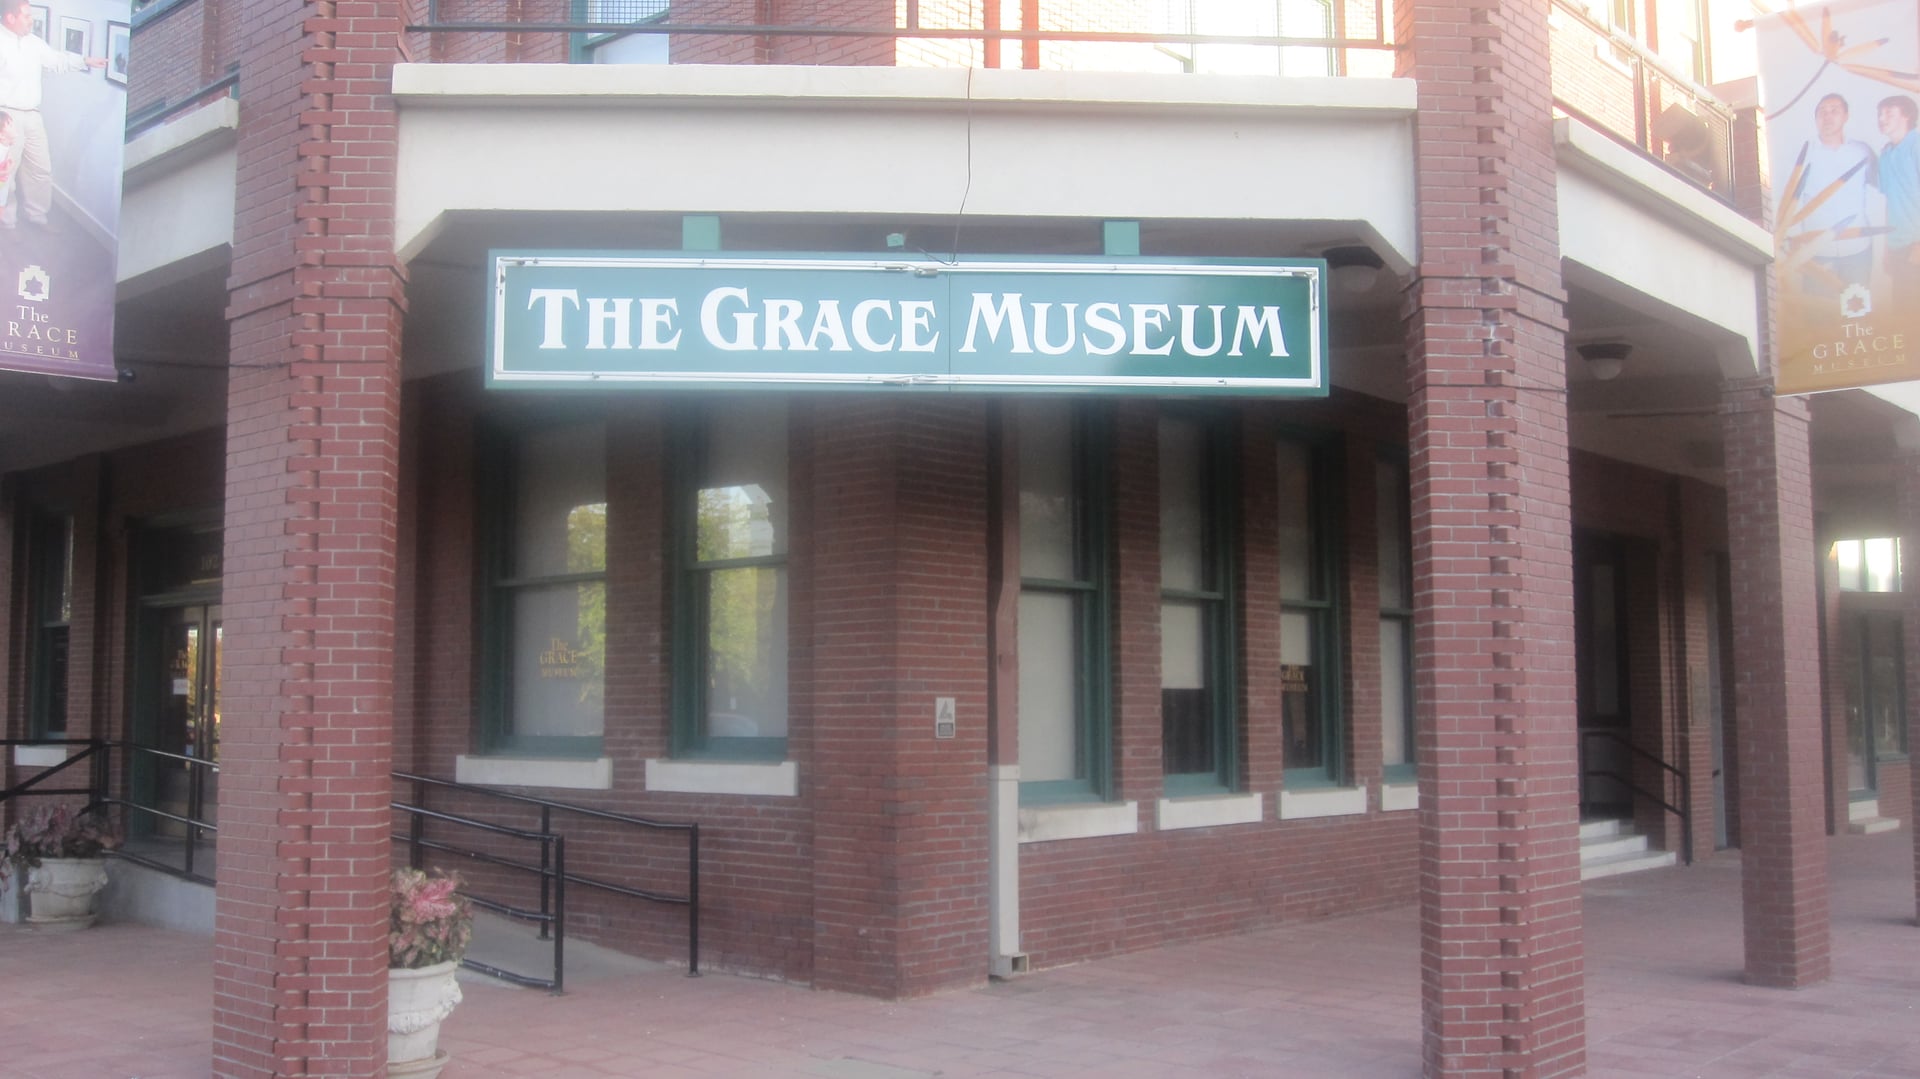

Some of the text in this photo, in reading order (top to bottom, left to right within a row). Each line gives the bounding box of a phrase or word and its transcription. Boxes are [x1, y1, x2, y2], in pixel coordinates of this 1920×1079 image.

[16, 304, 49, 323] The
[527, 286, 1291, 357] THE GRACE MUSEUM
[7, 321, 79, 345] RACE
[1841, 322, 1873, 338] The
[3, 341, 80, 359] USEUM
[1812, 334, 1905, 359] GRACE
